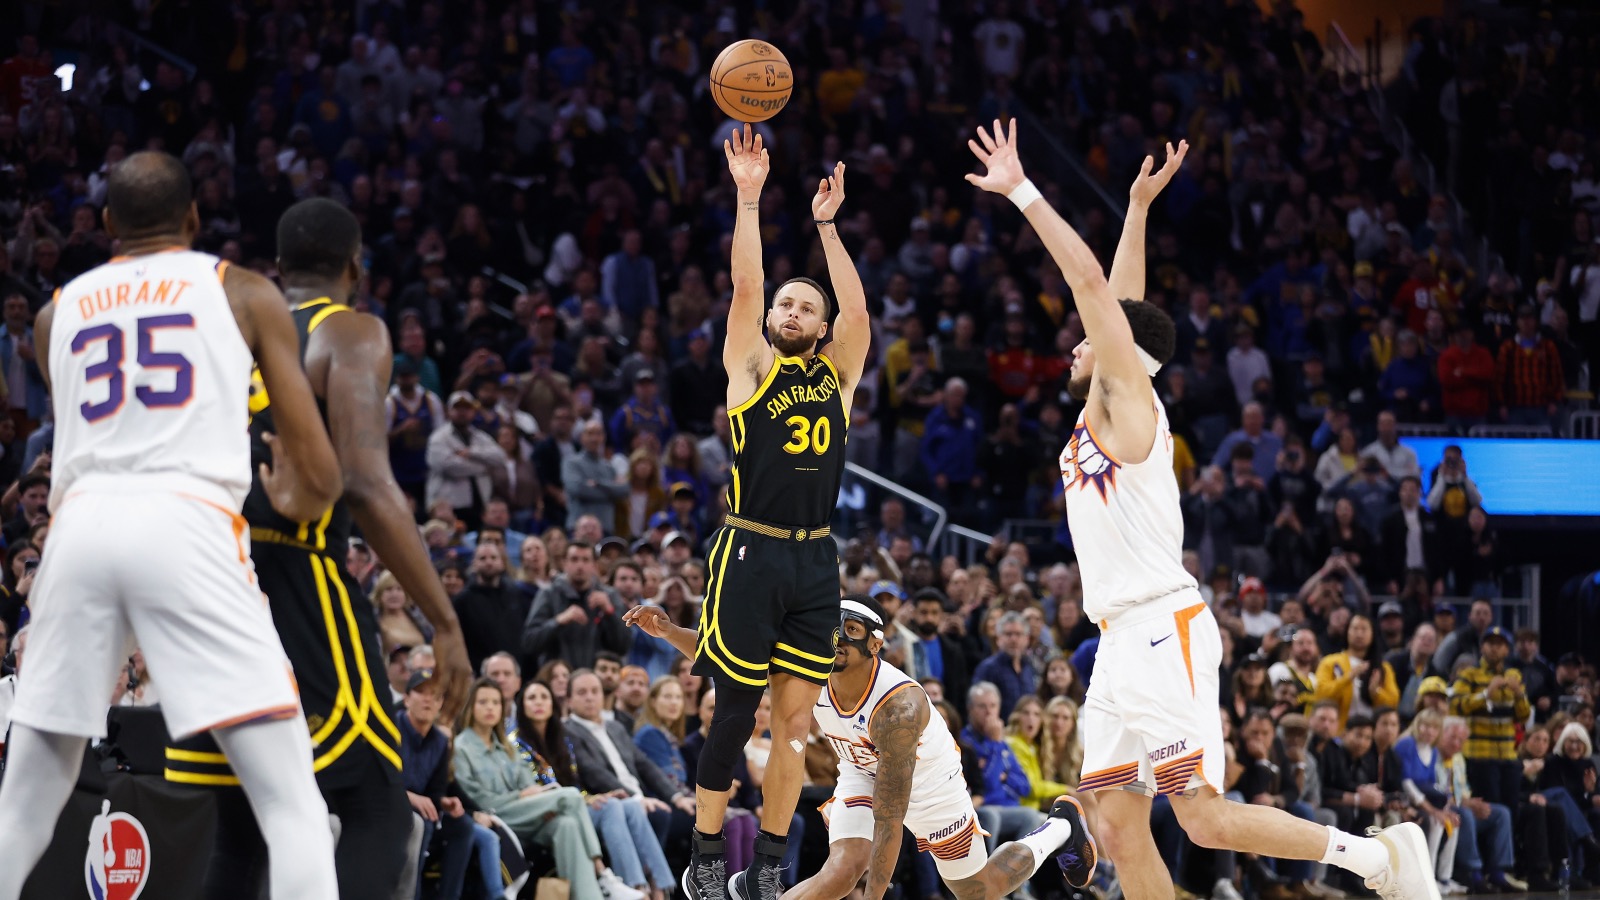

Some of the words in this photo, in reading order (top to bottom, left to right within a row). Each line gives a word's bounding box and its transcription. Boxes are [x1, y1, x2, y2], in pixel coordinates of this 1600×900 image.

[78, 278, 193, 321] DURANT
[70, 313, 196, 424] 35
[766, 390, 793, 420] SAN
[790, 375, 837, 403] FRACISCO
[782, 415, 831, 456] 30
[1148, 738, 1188, 763] HOENIX
[929, 811, 968, 842] PHOENIX
[108, 868, 141, 884] ESPN
[125, 848, 142, 868] NBA
